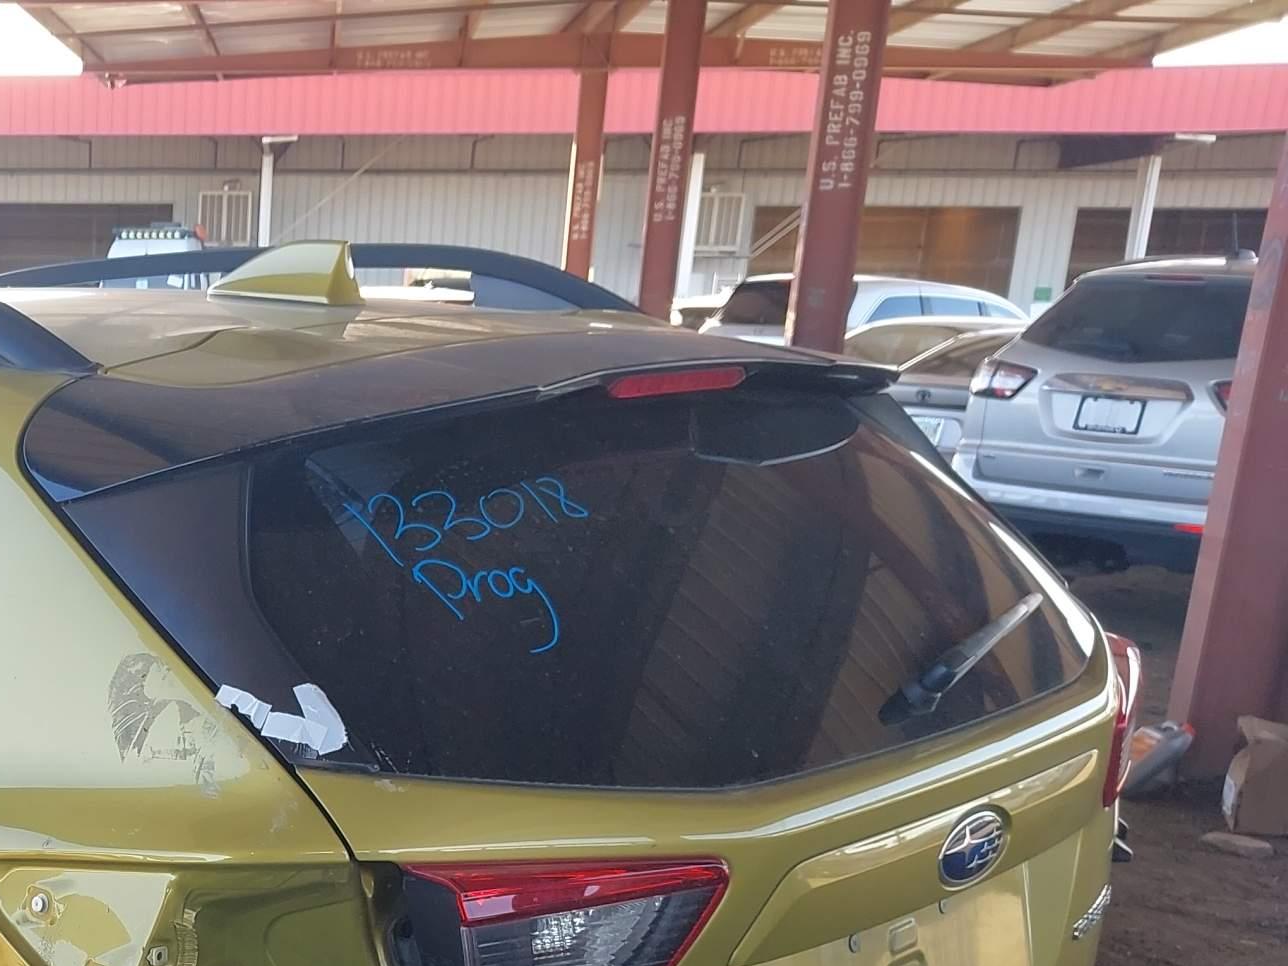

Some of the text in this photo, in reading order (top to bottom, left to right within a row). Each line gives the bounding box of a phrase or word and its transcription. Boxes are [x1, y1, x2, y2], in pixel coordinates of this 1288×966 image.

[819, 30, 855, 191] U.S. PREFAB INC.
[838, 31, 872, 188] 1-866-799-0969
